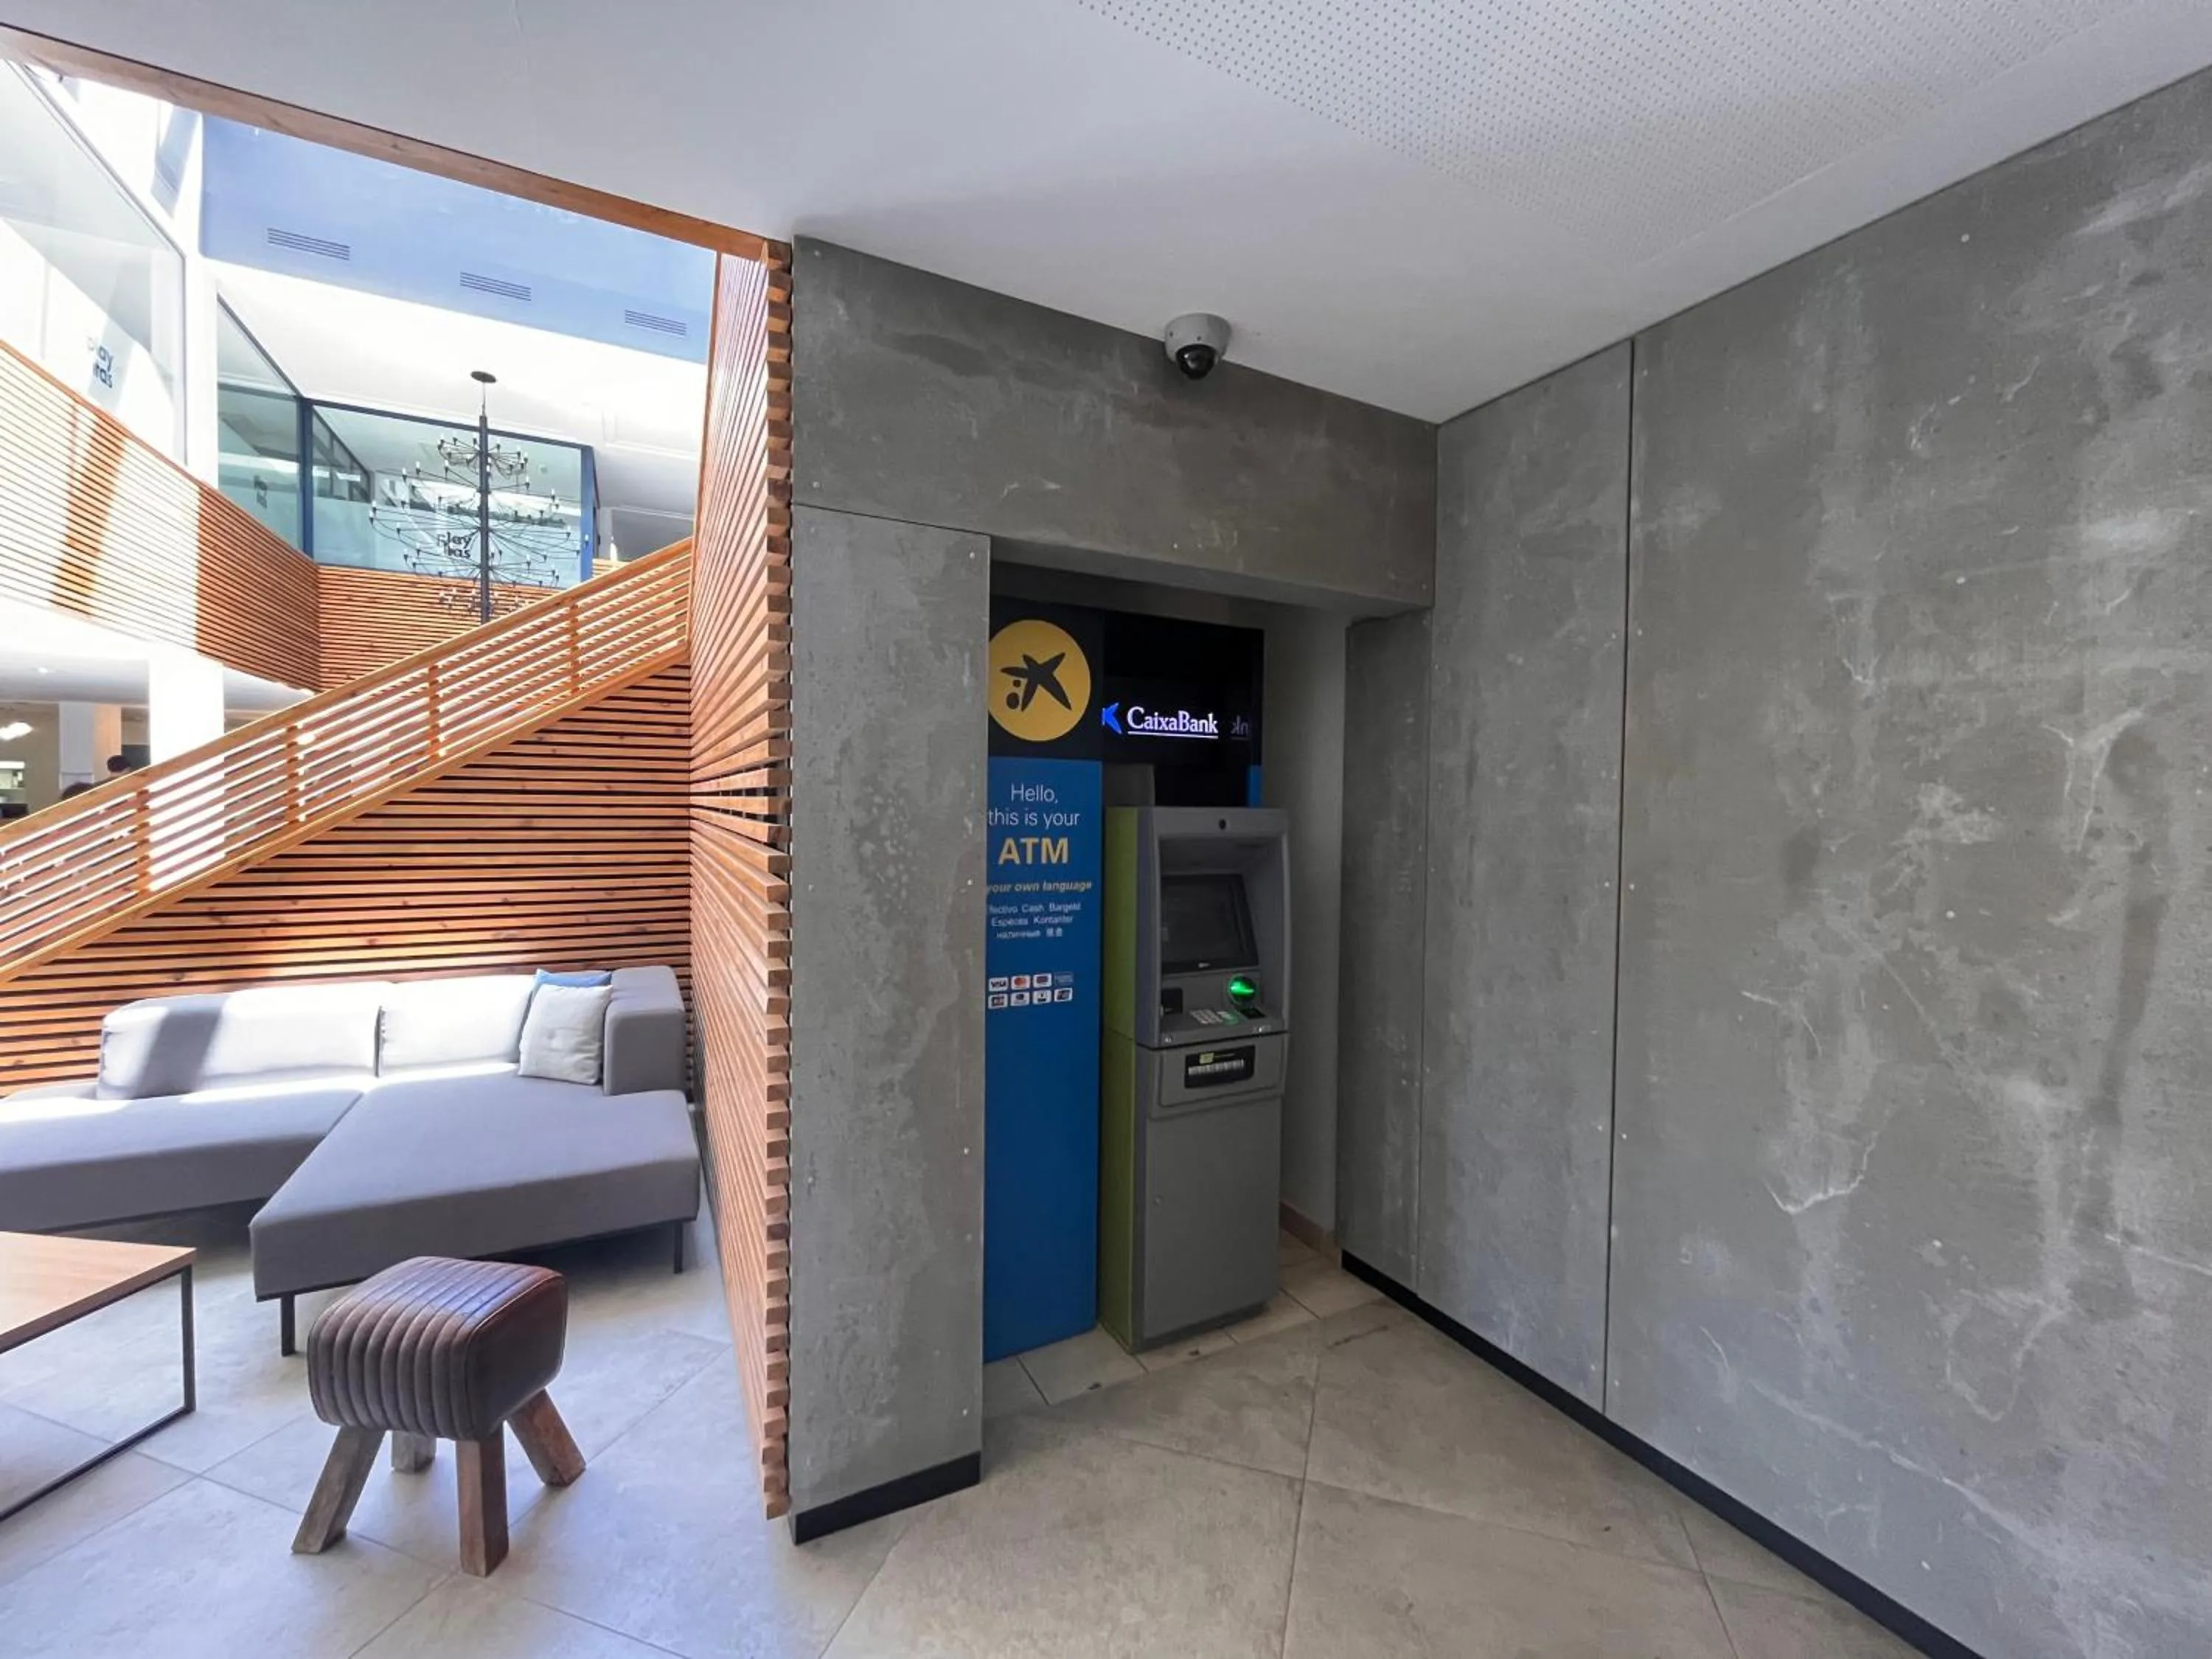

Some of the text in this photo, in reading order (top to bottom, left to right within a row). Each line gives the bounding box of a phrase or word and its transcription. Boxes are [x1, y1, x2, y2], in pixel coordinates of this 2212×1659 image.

[1127, 706, 1218, 734] CaixaBank
[1011, 783, 1058, 804] Hello,
[988, 807, 1079, 830] this is your
[998, 838, 1068, 865] ATM
[1015, 882, 1040, 891] own
[1043, 880, 1093, 892] language
